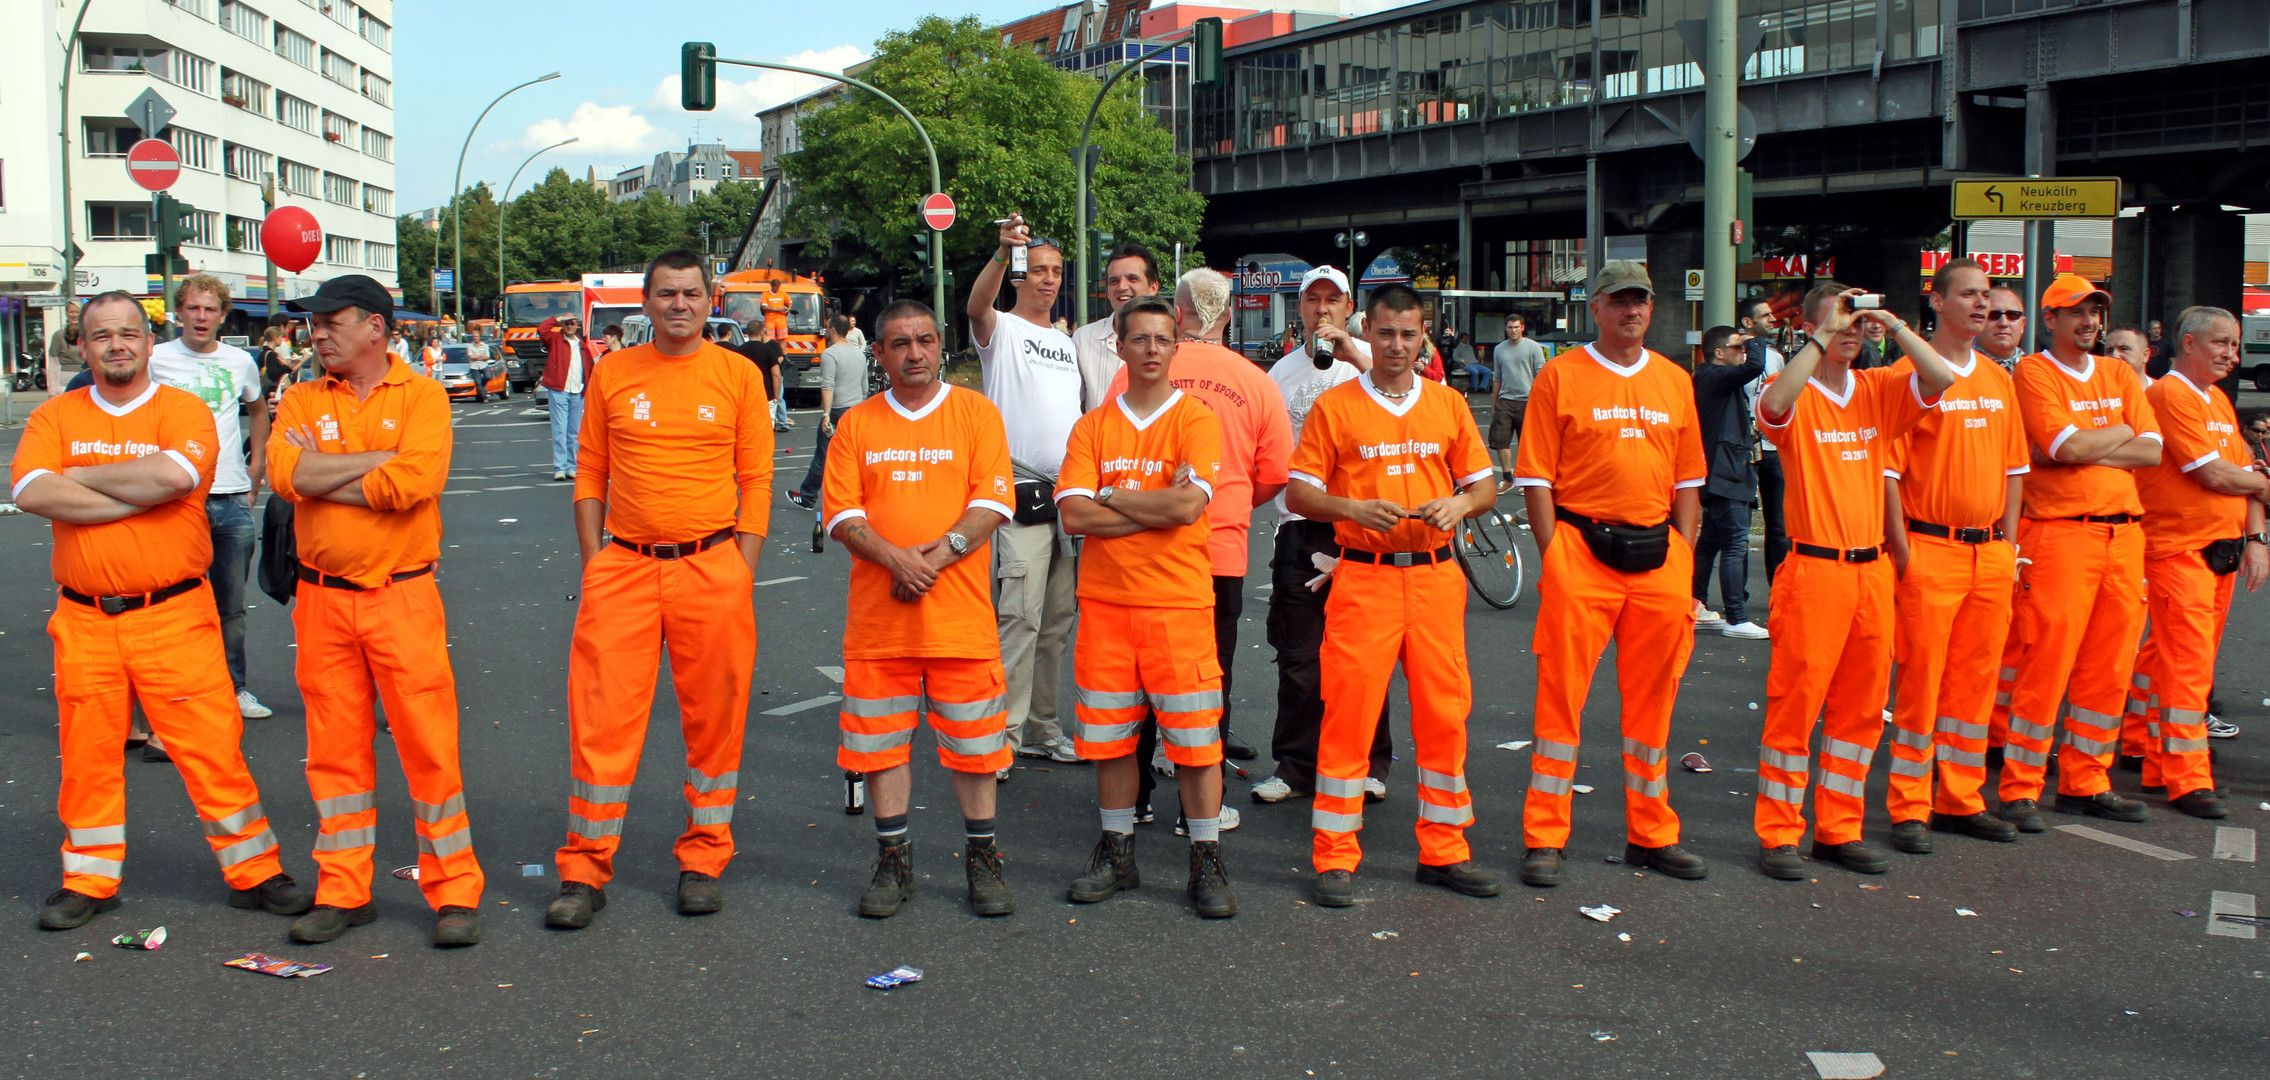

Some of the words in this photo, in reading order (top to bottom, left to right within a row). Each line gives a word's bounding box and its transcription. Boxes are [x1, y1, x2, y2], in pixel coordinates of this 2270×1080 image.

[2020, 186, 2077, 197] Neukölln
[2020, 200, 2086, 213] Kreuzberg
[33, 268, 47, 277] 106
[716, 262, 726, 275] U
[1023, 338, 1074, 365] Nackt
[1199, 379, 1213, 390] OF
[1213, 382, 1246, 408] SPORTS
[1639, 406, 1670, 425] fegen
[320, 420, 338, 430] LAUB
[1621, 427, 1634, 438] CSD
[1359, 441, 1407, 460] Hardcore
[1408, 439, 1440, 459] fegen
[1852, 449, 1868, 461] 2011
[865, 447, 917, 466] Hardcore
[919, 447, 953, 464] fegen
[892, 470, 906, 482] CSD
[907, 470, 923, 482] 2011
[1387, 464, 1402, 476] CSD
[1126, 478, 1142, 491] 2011
